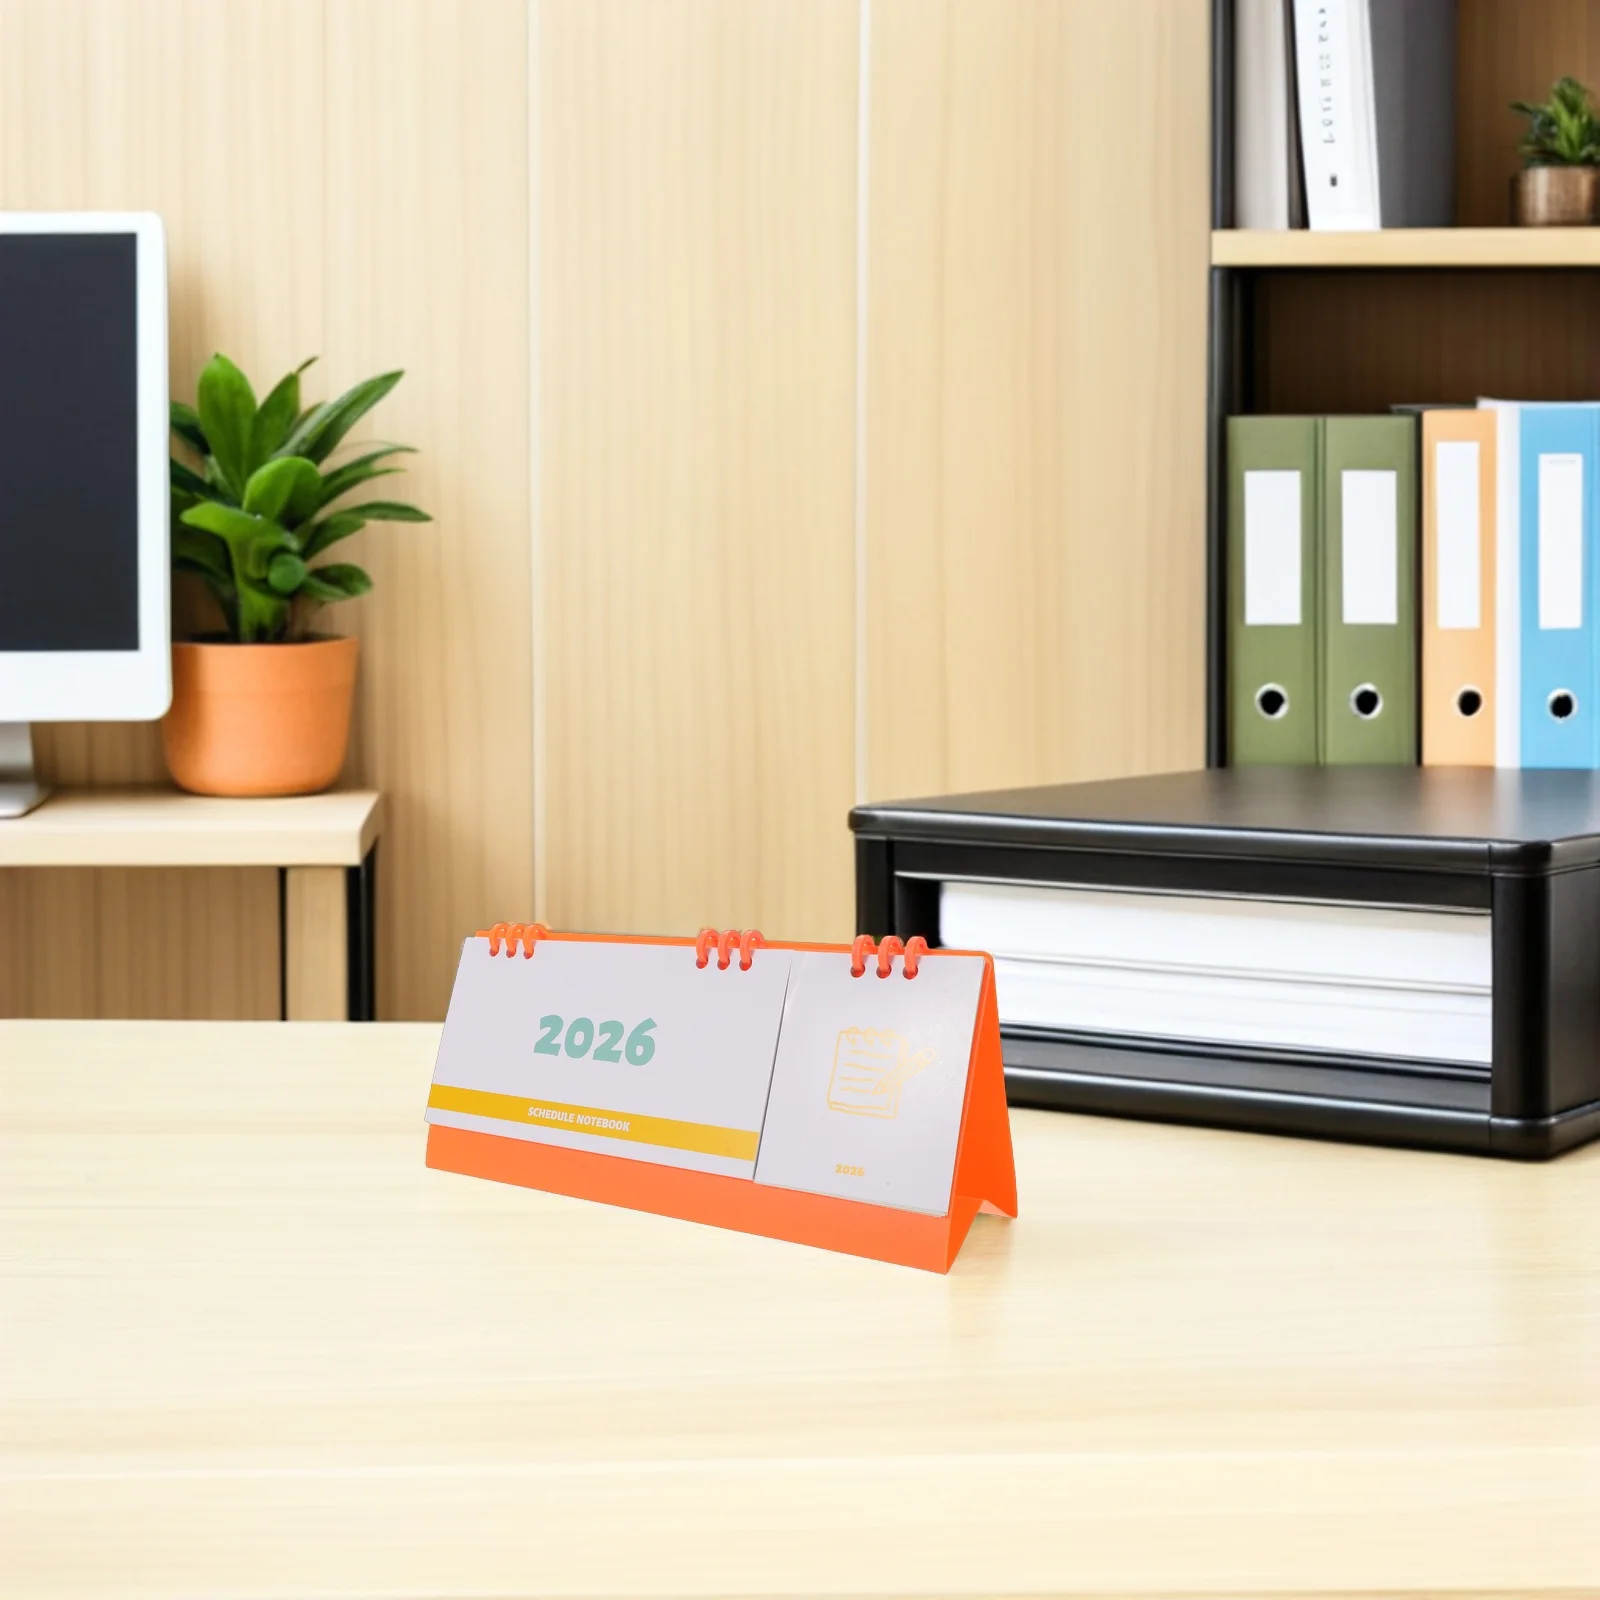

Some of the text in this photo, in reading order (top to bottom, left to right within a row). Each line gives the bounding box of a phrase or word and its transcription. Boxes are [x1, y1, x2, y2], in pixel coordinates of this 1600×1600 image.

[533, 1014, 658, 1067] 2026
[527, 1106, 631, 1132] SCHEDULE NOTEBOOK
[834, 1162, 865, 1177] 2026
